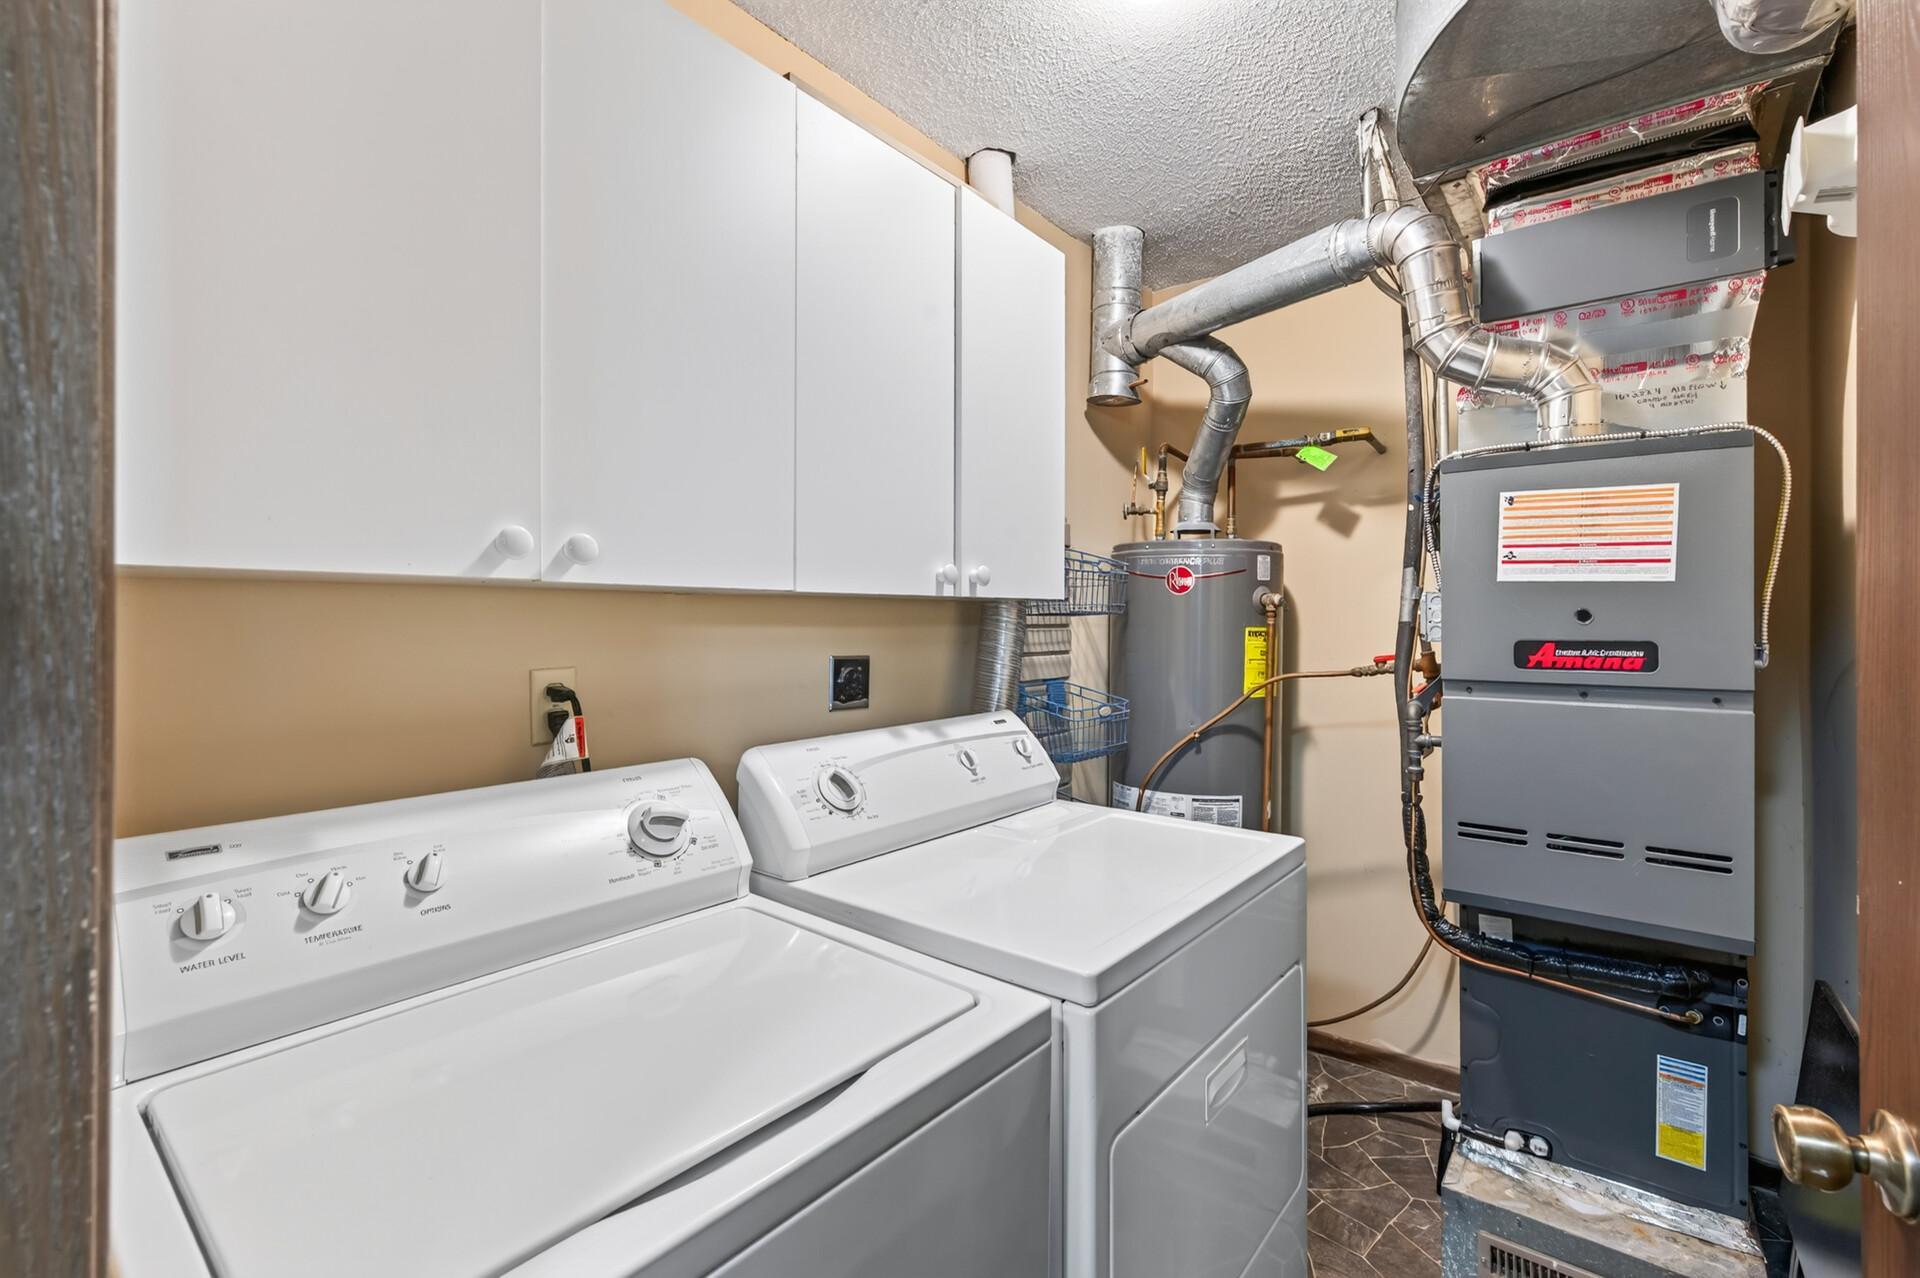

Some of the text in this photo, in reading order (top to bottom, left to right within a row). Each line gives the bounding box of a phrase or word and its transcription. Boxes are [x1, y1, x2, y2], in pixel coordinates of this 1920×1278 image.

[1526, 642, 1647, 671] Amana
[304, 924, 363, 944] TEMPERATURE
[179, 952, 246, 974] WATER LEVEL
